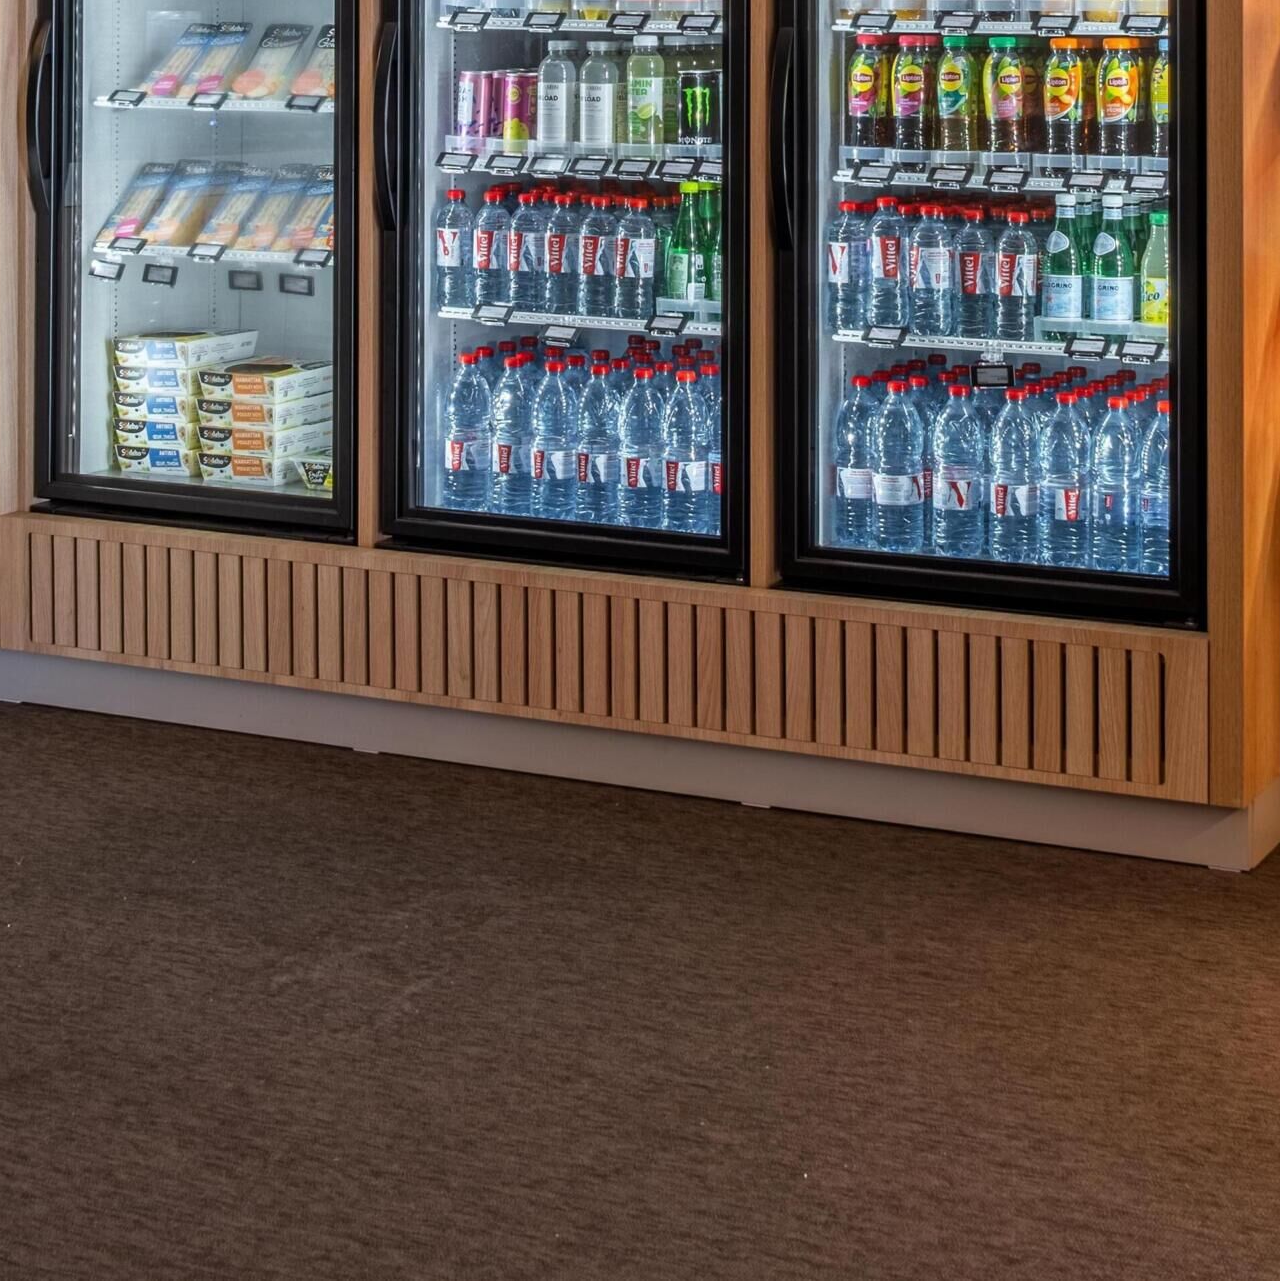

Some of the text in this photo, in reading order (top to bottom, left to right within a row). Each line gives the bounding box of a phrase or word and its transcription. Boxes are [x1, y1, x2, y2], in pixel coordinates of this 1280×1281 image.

[477, 231, 489, 267] Vittel
[509, 232, 518, 267] Vittel
[550, 236, 562, 270] Vittel
[583, 238, 595, 271] Vittel
[616, 238, 627, 273] Vittel
[884, 239, 896, 277] Vittel
[964, 255, 975, 293] Vittel
[1000, 256, 1011, 295] Vittel
[996, 486, 1005, 515] Vittel
[1066, 490, 1077, 519] Vittel
